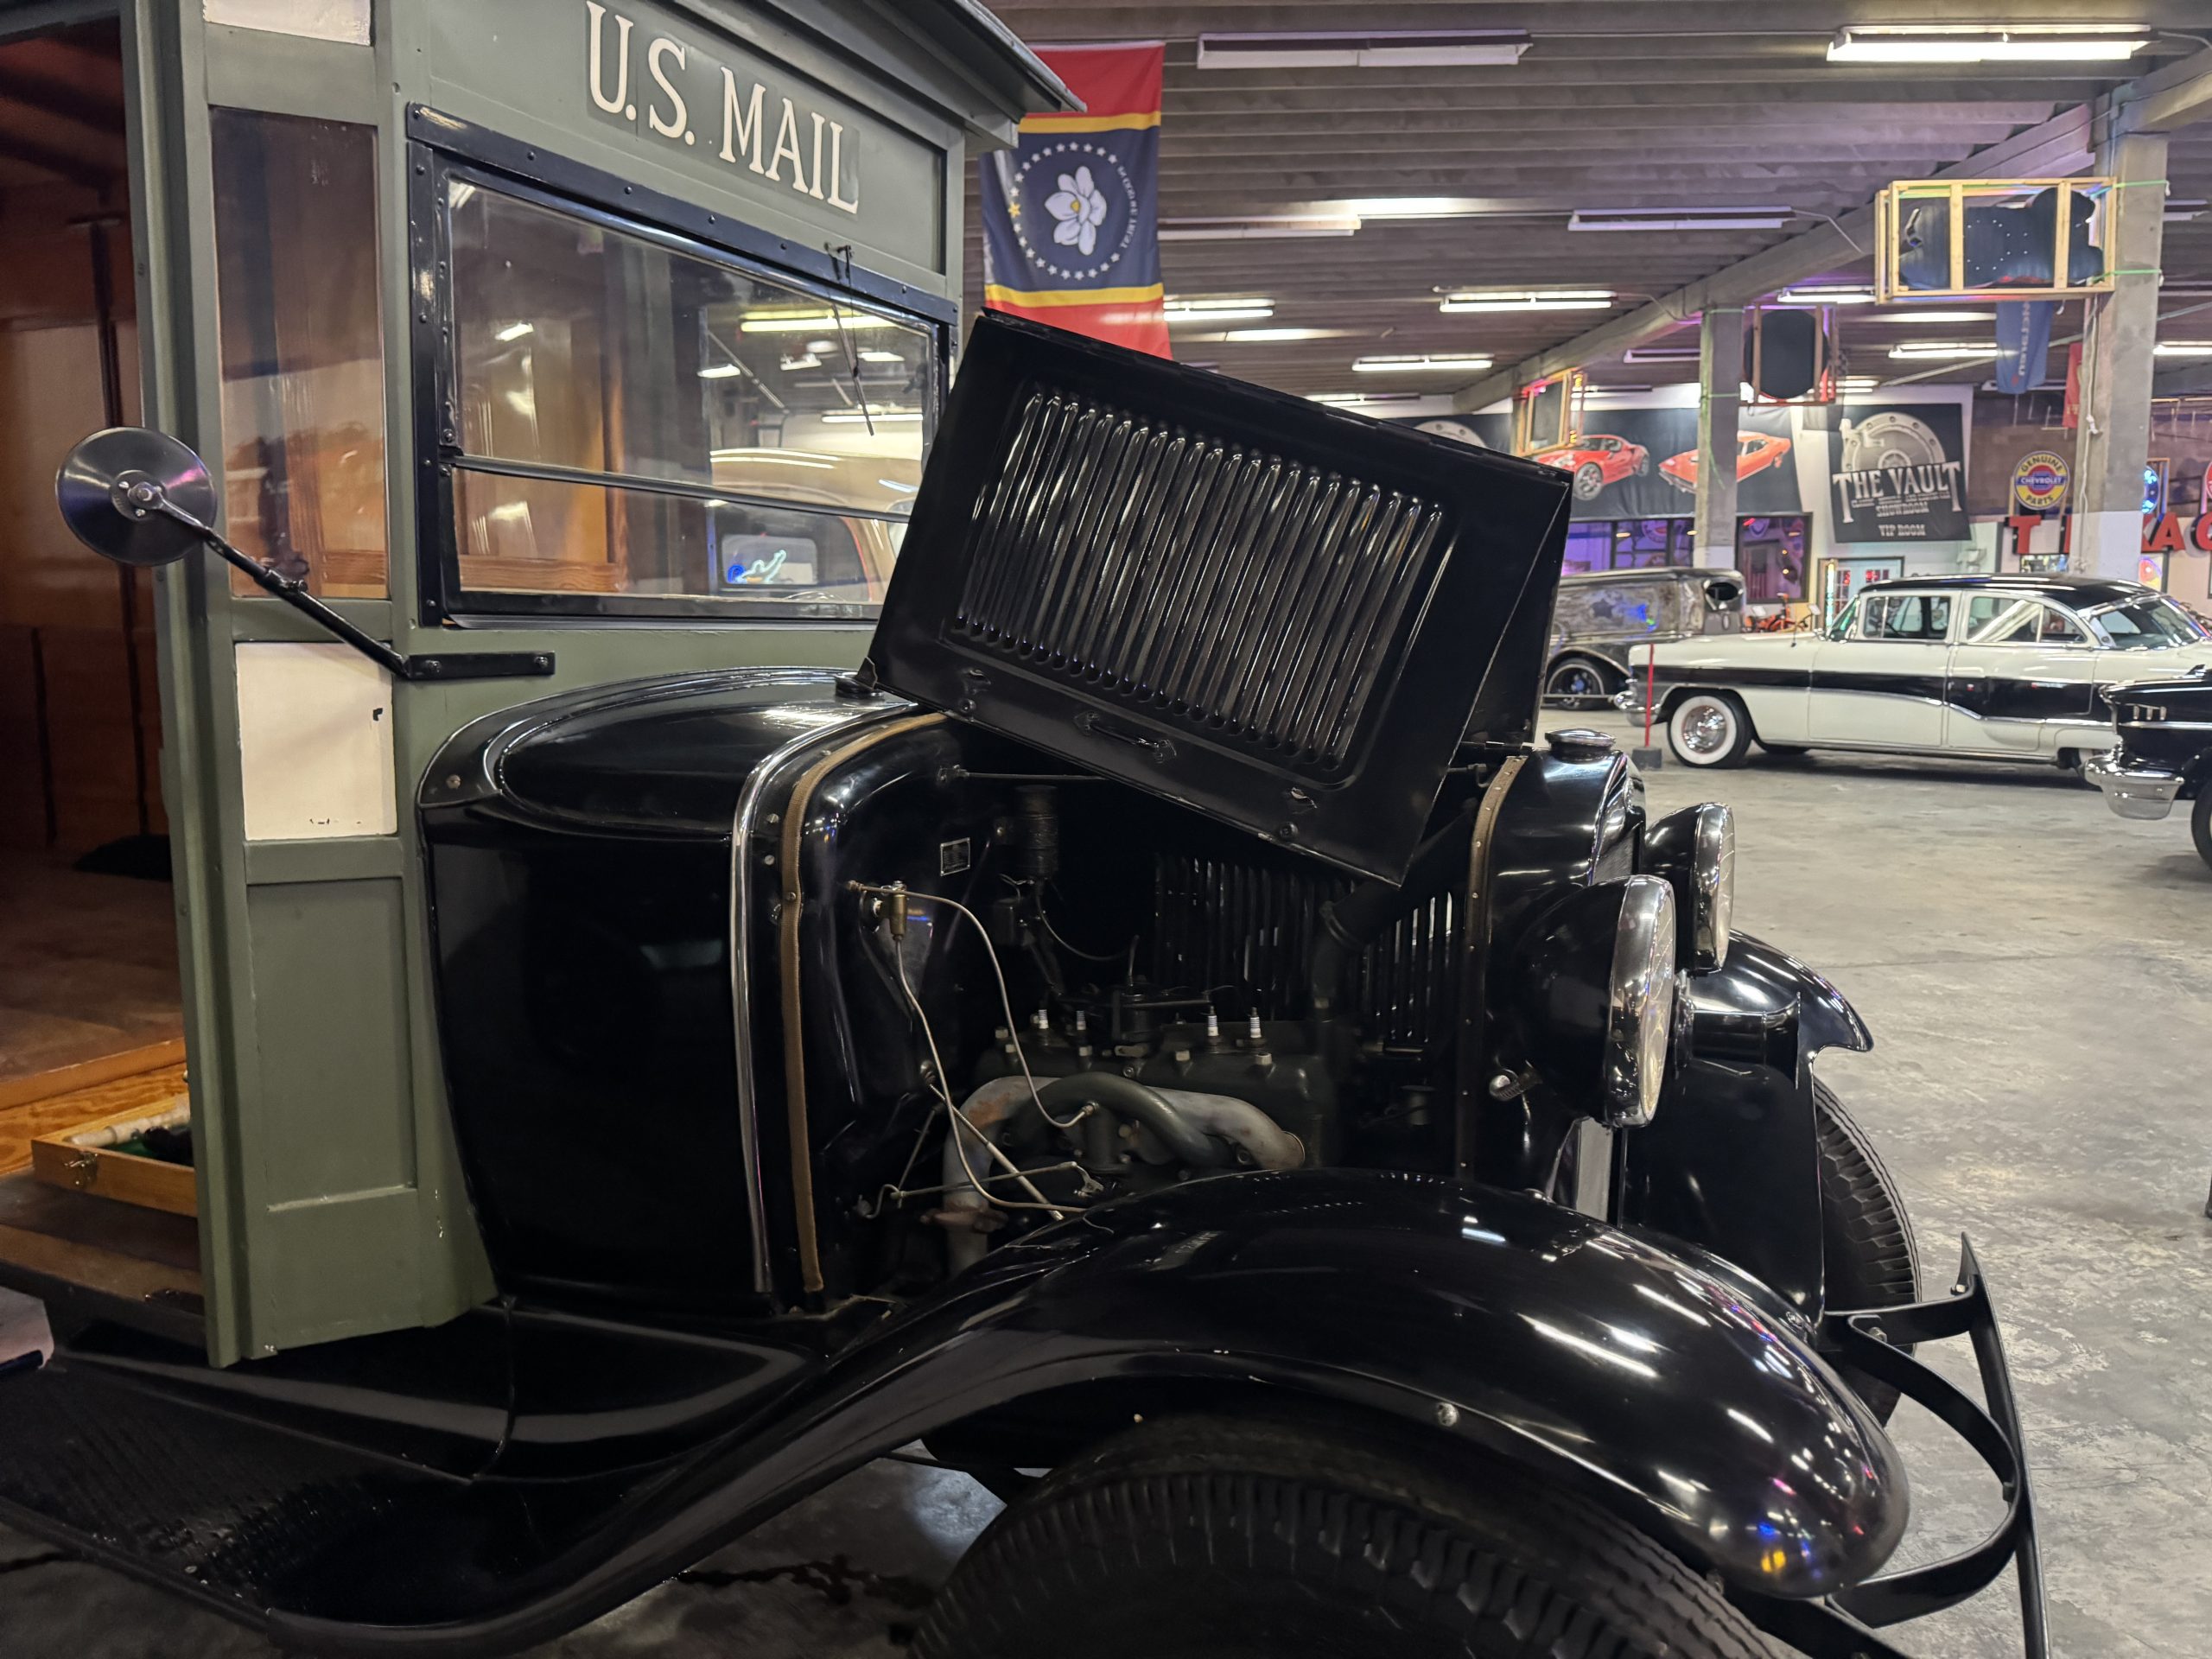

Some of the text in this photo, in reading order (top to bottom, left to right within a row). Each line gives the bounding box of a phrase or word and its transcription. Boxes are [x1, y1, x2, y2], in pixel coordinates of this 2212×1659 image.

[587, 1, 859, 214] U.S. MAIL
[2020, 455, 2063, 473] GENUINE
[1832, 461, 1963, 524] THE VAULT
[2025, 493, 2054, 505] PARTS
[1875, 501, 1929, 518] SHOWROOM
[1878, 524, 1927, 537] VIP ROOM
